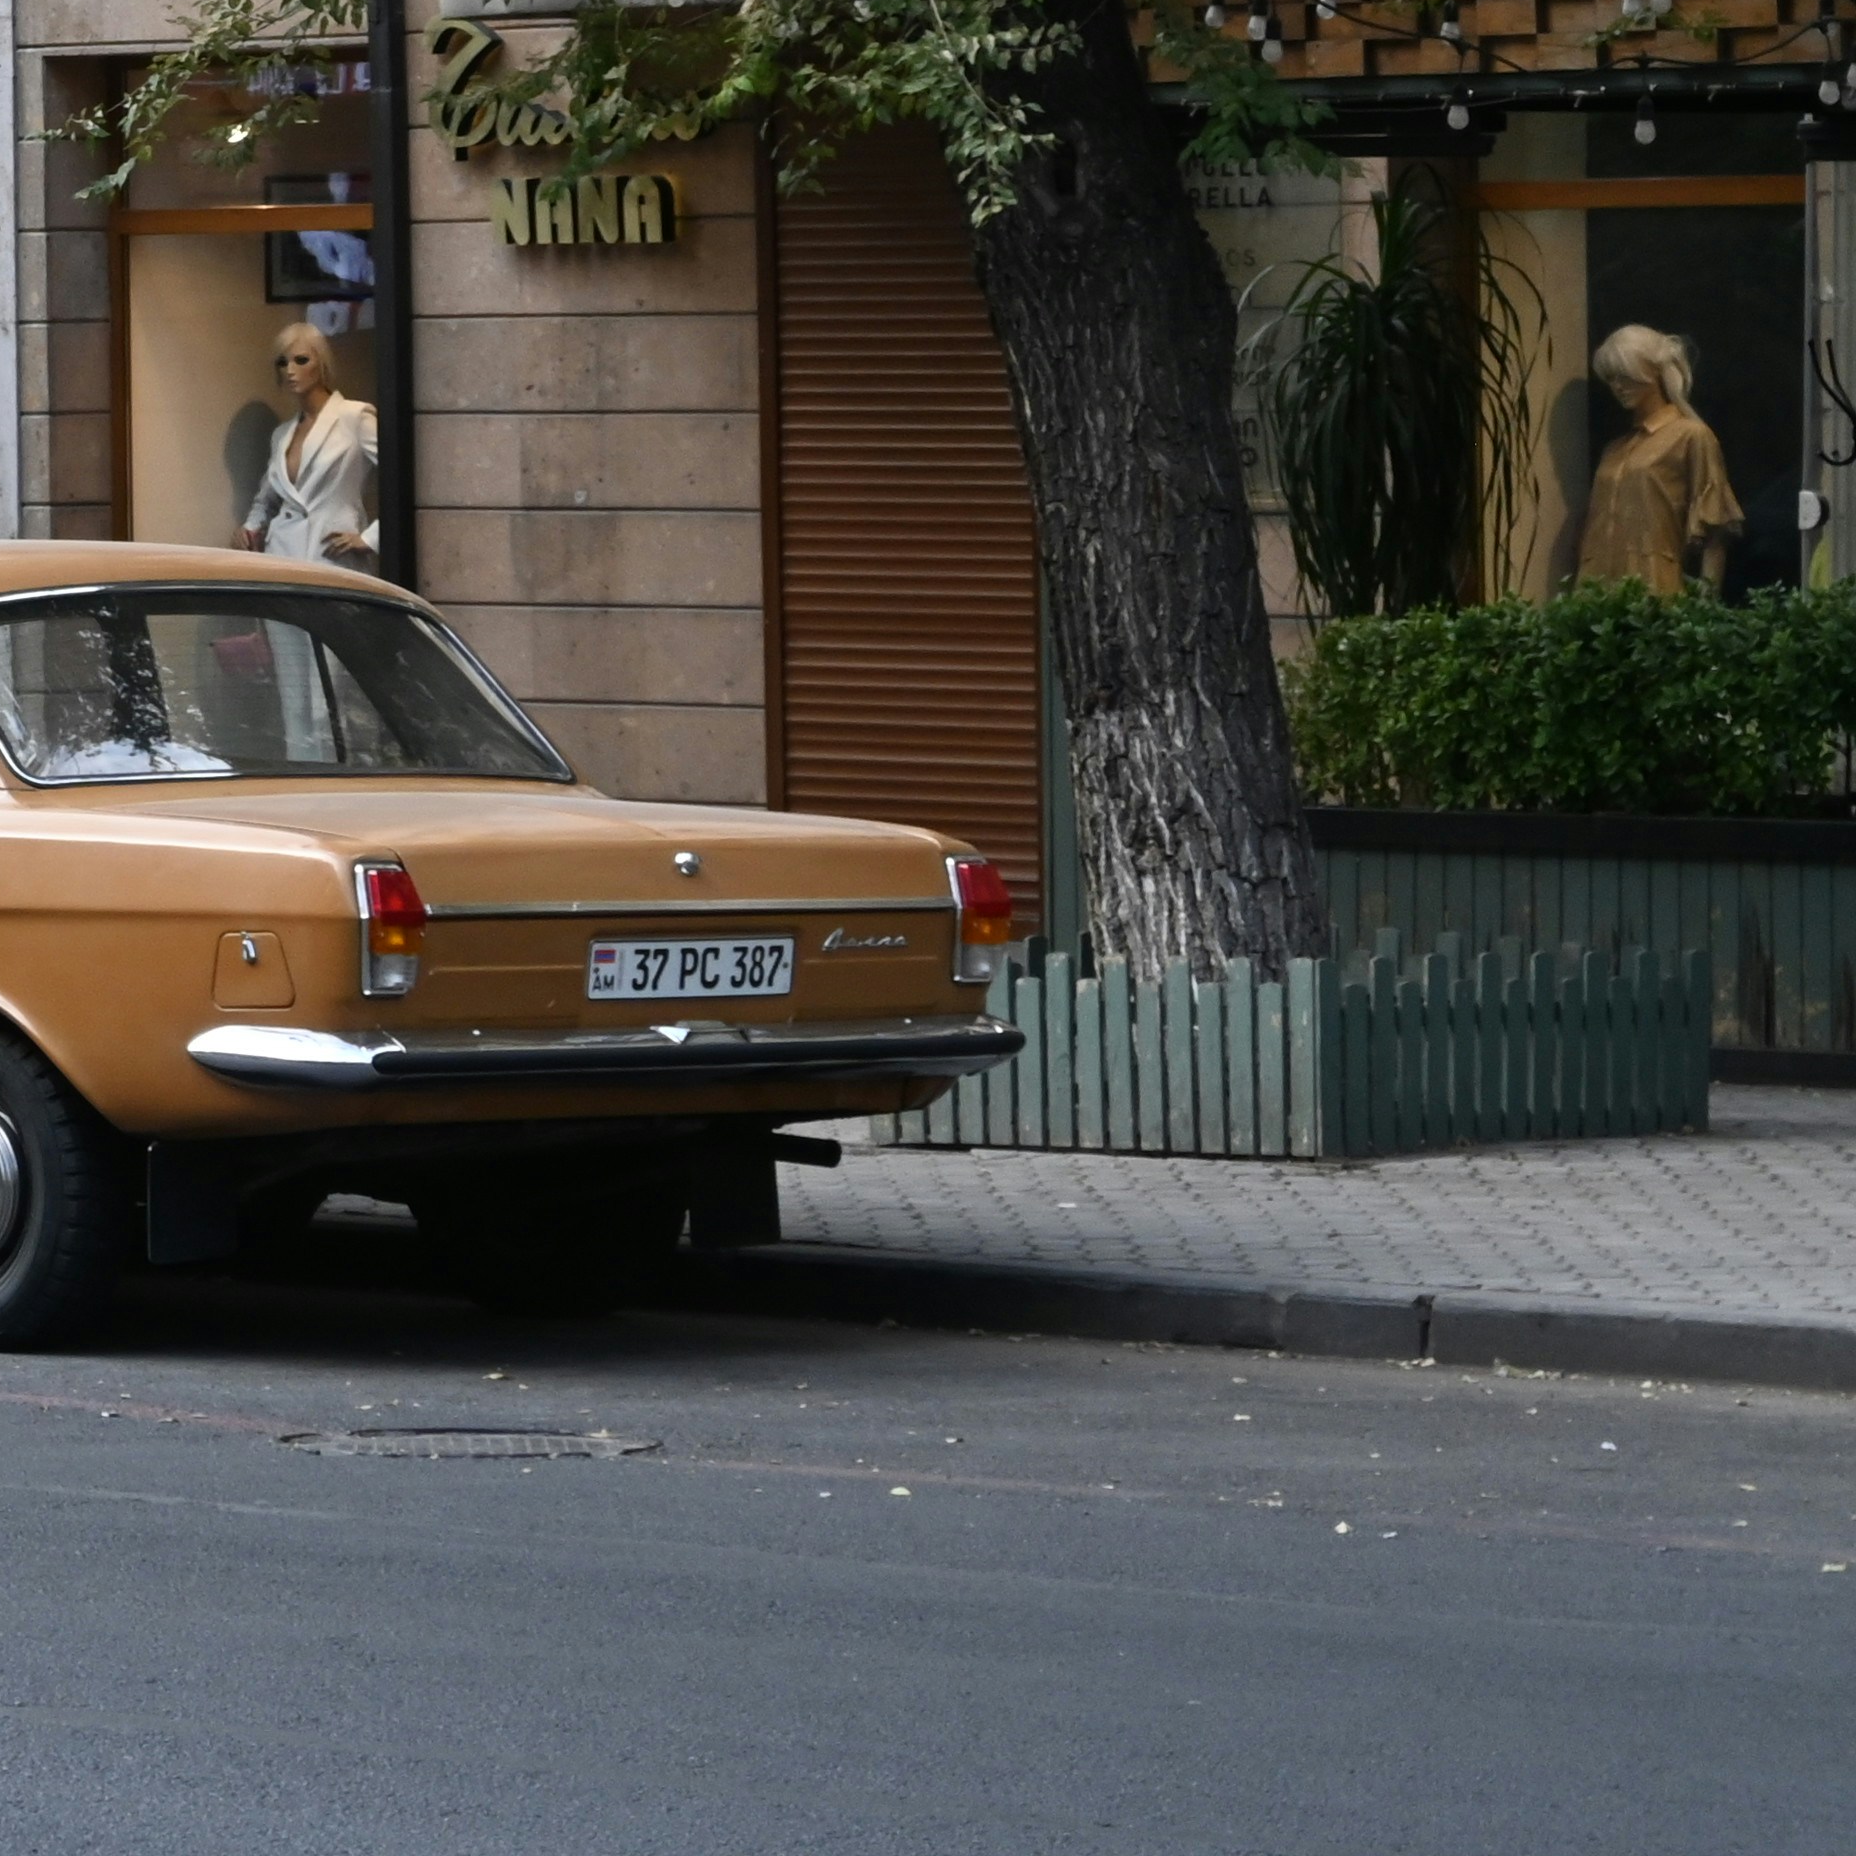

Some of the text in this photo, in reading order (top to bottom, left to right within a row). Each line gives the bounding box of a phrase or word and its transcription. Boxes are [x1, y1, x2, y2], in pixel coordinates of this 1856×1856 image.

[490, 175, 670, 245] NANA
[631, 945, 785, 992] 37 PC 387
